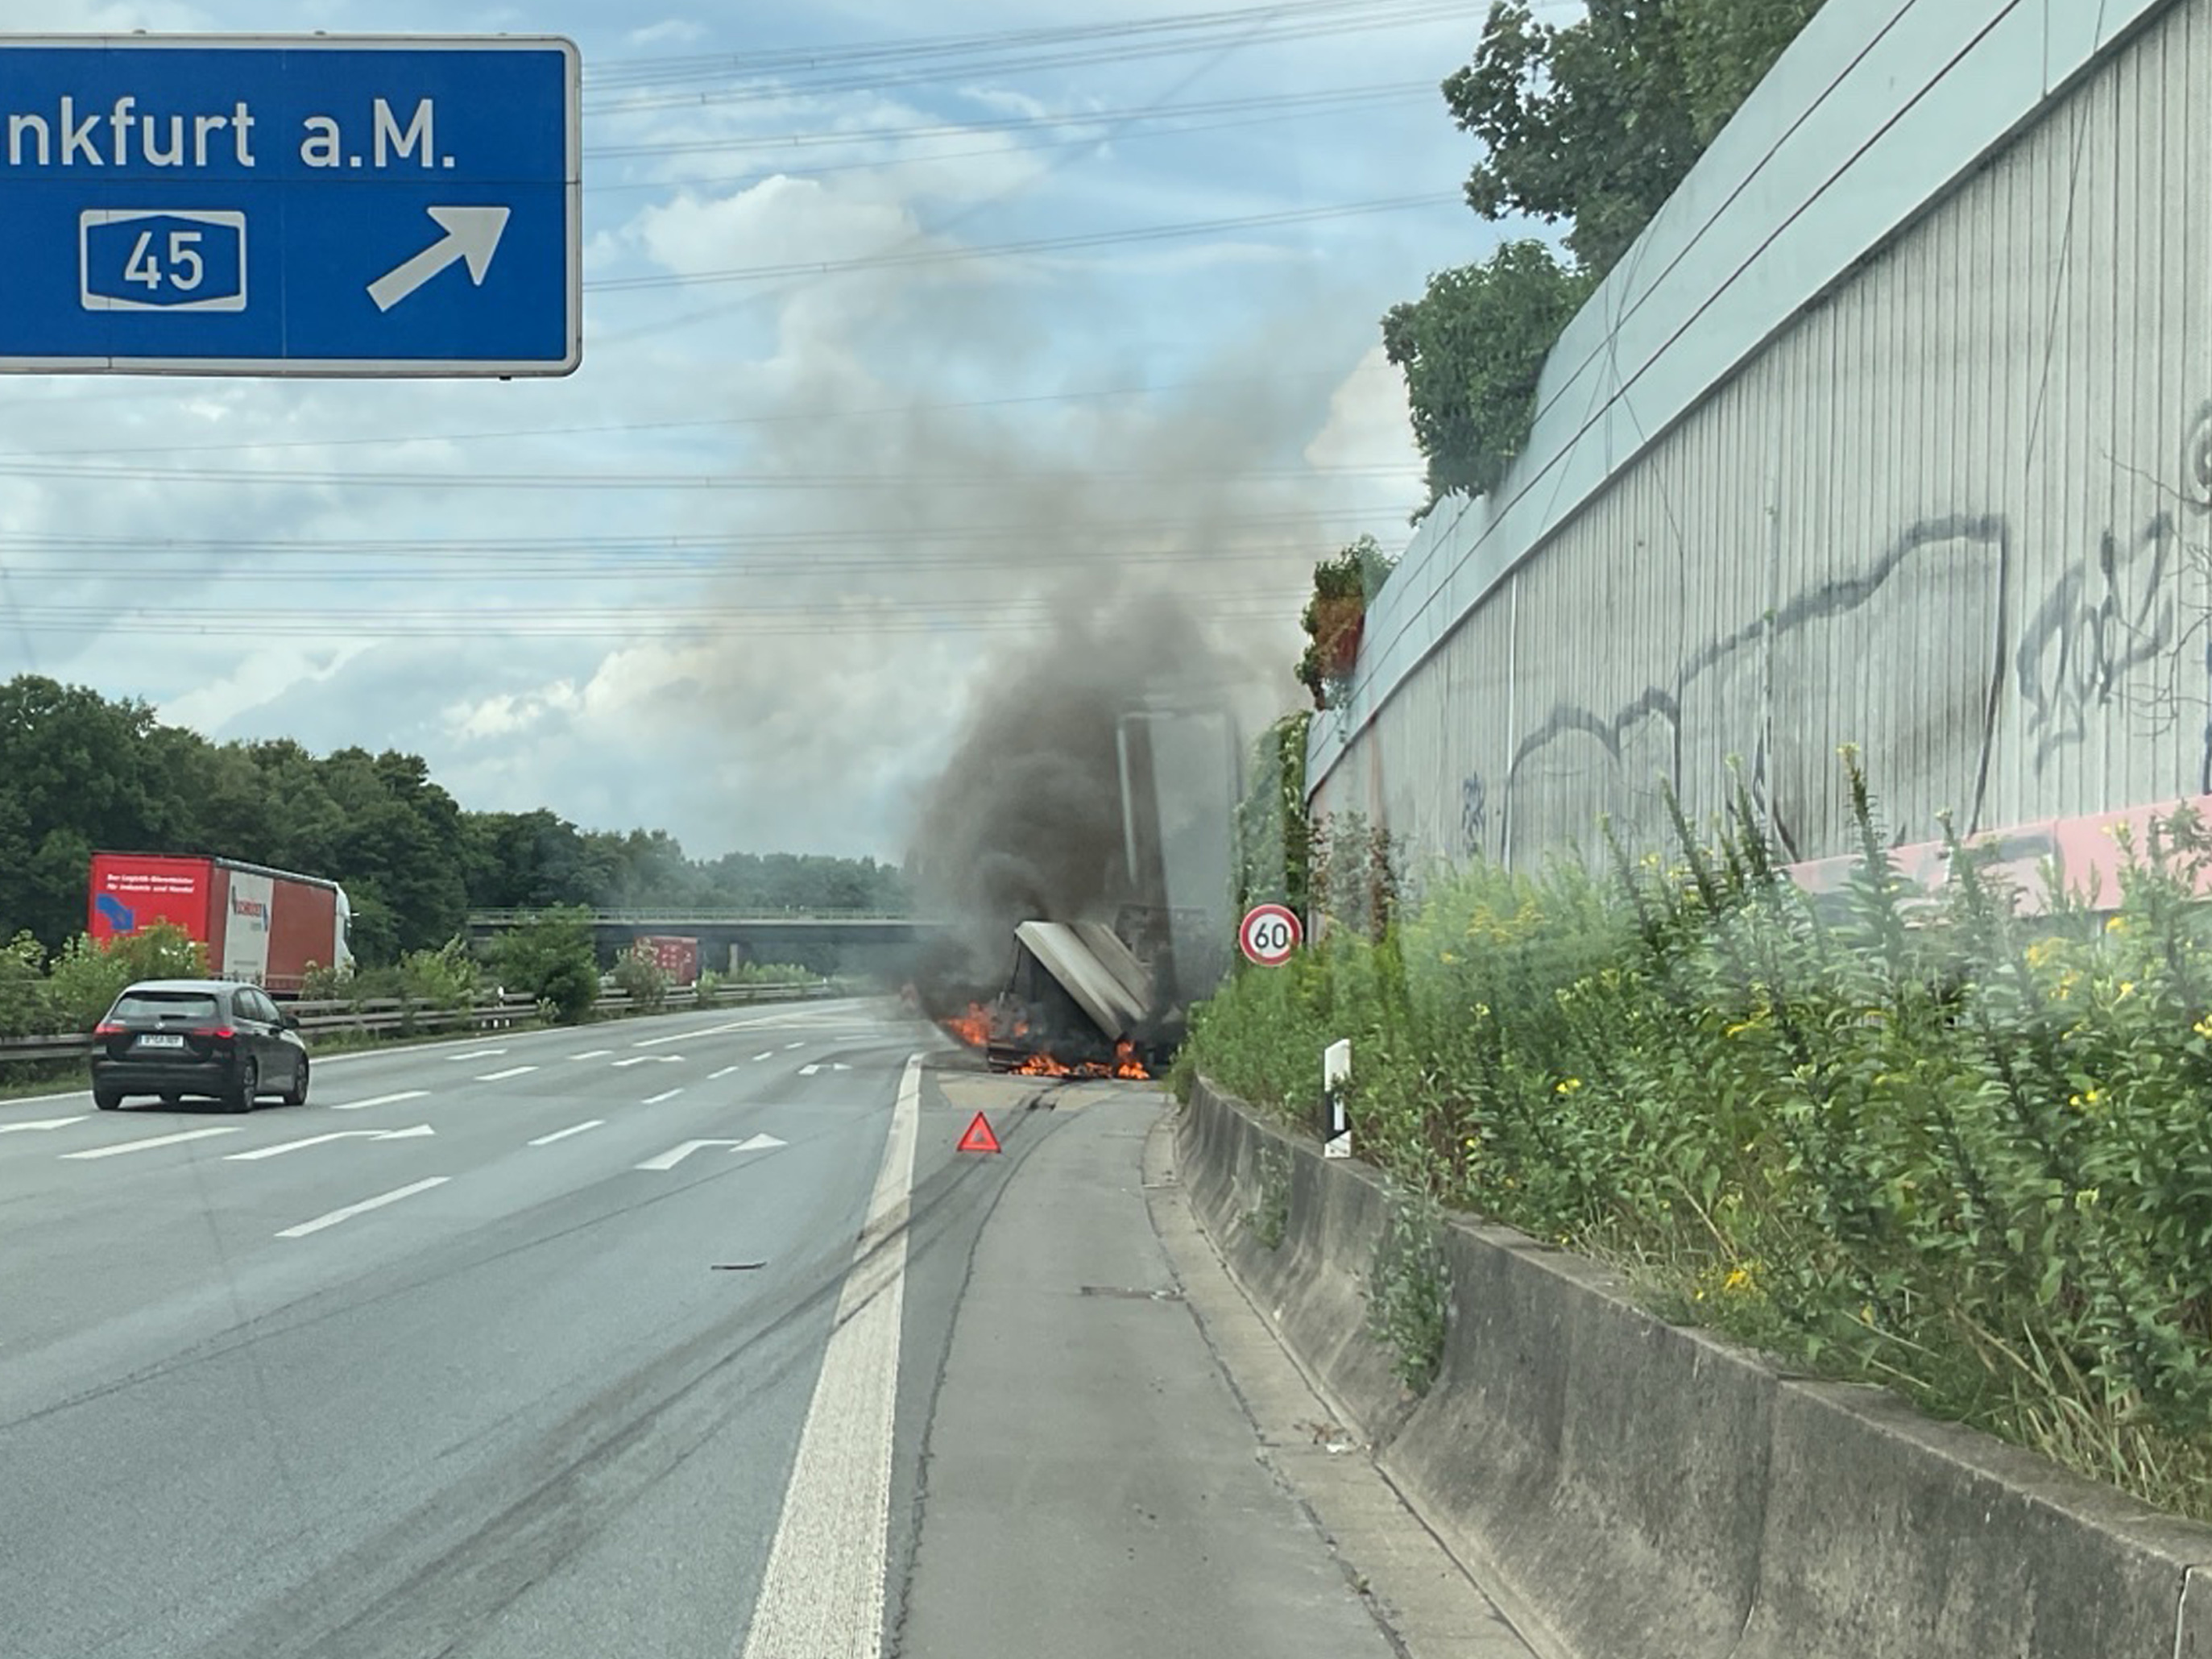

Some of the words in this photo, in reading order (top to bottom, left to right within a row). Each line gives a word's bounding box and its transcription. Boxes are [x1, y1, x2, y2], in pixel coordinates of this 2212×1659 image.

[9, 96, 255, 167] nkfurt
[300, 98, 455, 168] a.M.
[124, 231, 203, 290] 45
[1254, 923, 1287, 949] 60
